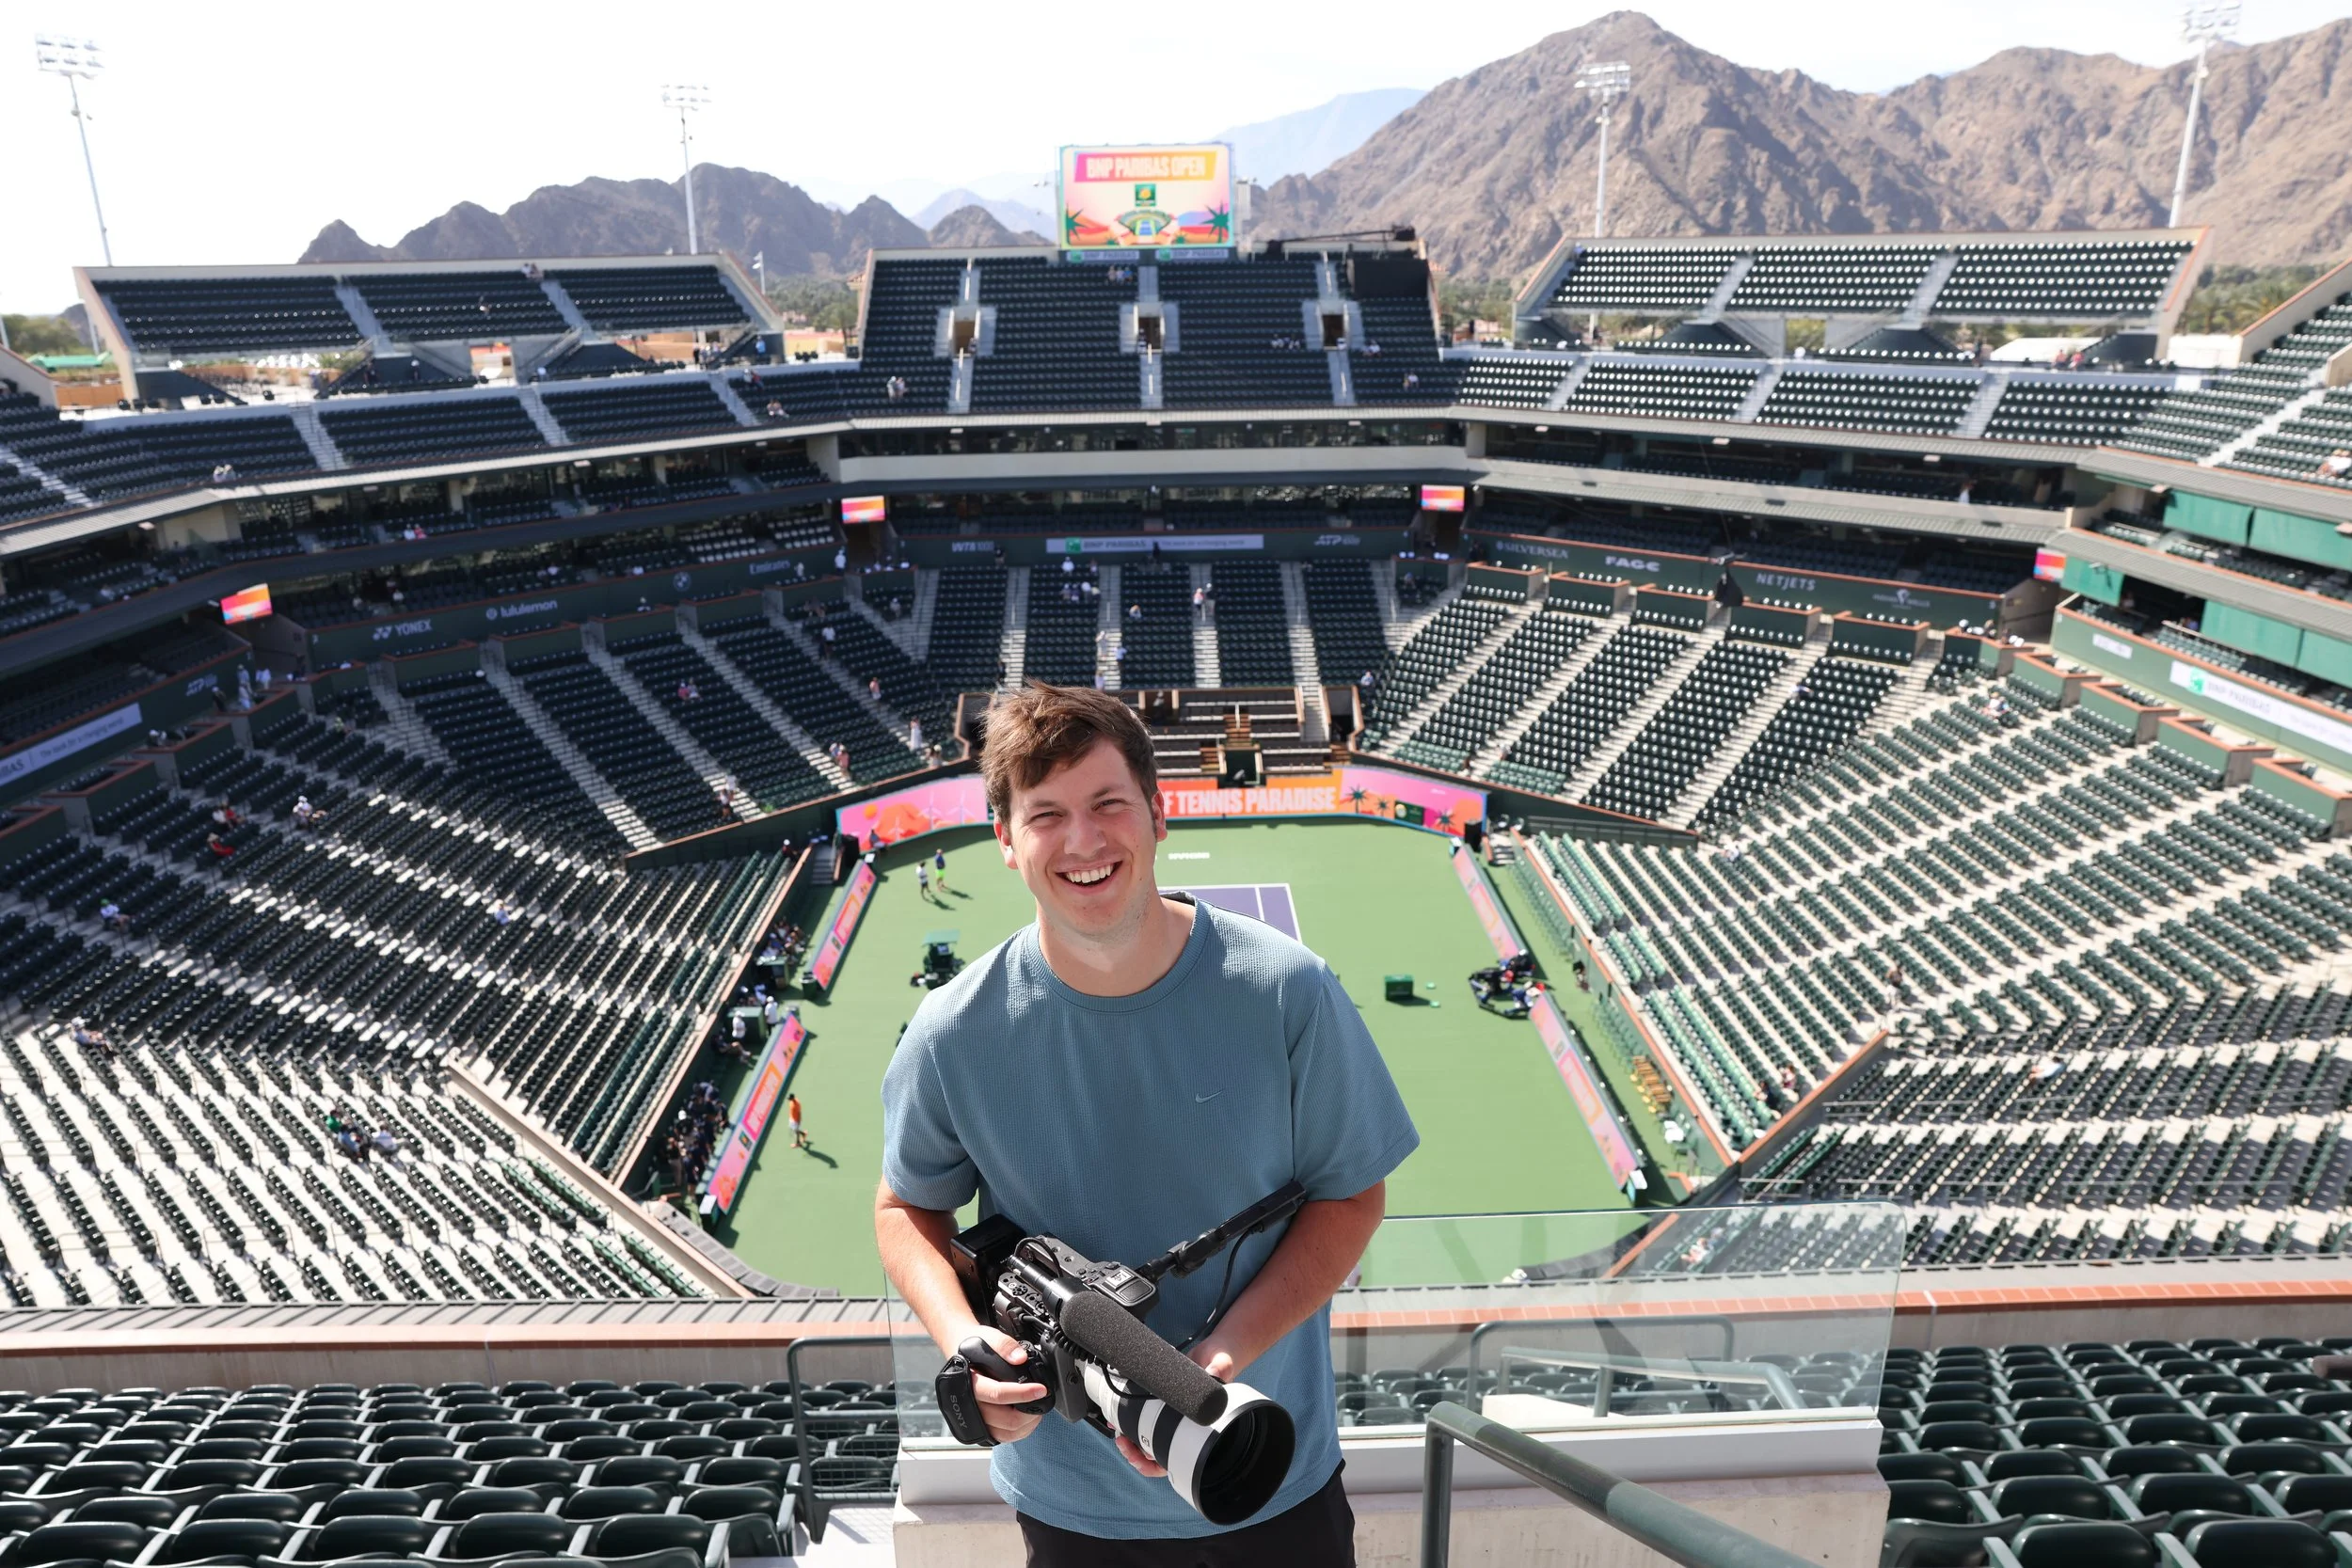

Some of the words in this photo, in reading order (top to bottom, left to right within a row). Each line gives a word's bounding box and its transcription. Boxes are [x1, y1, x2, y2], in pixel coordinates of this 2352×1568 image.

[1086, 157, 1114, 179] BNP
[1114, 156, 1170, 179] PARIBAS
[1171, 155, 1206, 178] OPEN
[1503, 543, 1569, 560] SILVERSEA
[749, 559, 791, 576] Emirates
[1756, 573, 1816, 592] NETJETS
[500, 599, 558, 618] lululemon
[394, 619, 432, 637] YONEX
[1176, 789, 1243, 815] TENNIS
[1245, 786, 1336, 814] PARADISE
[950, 1394, 968, 1429] SONY
